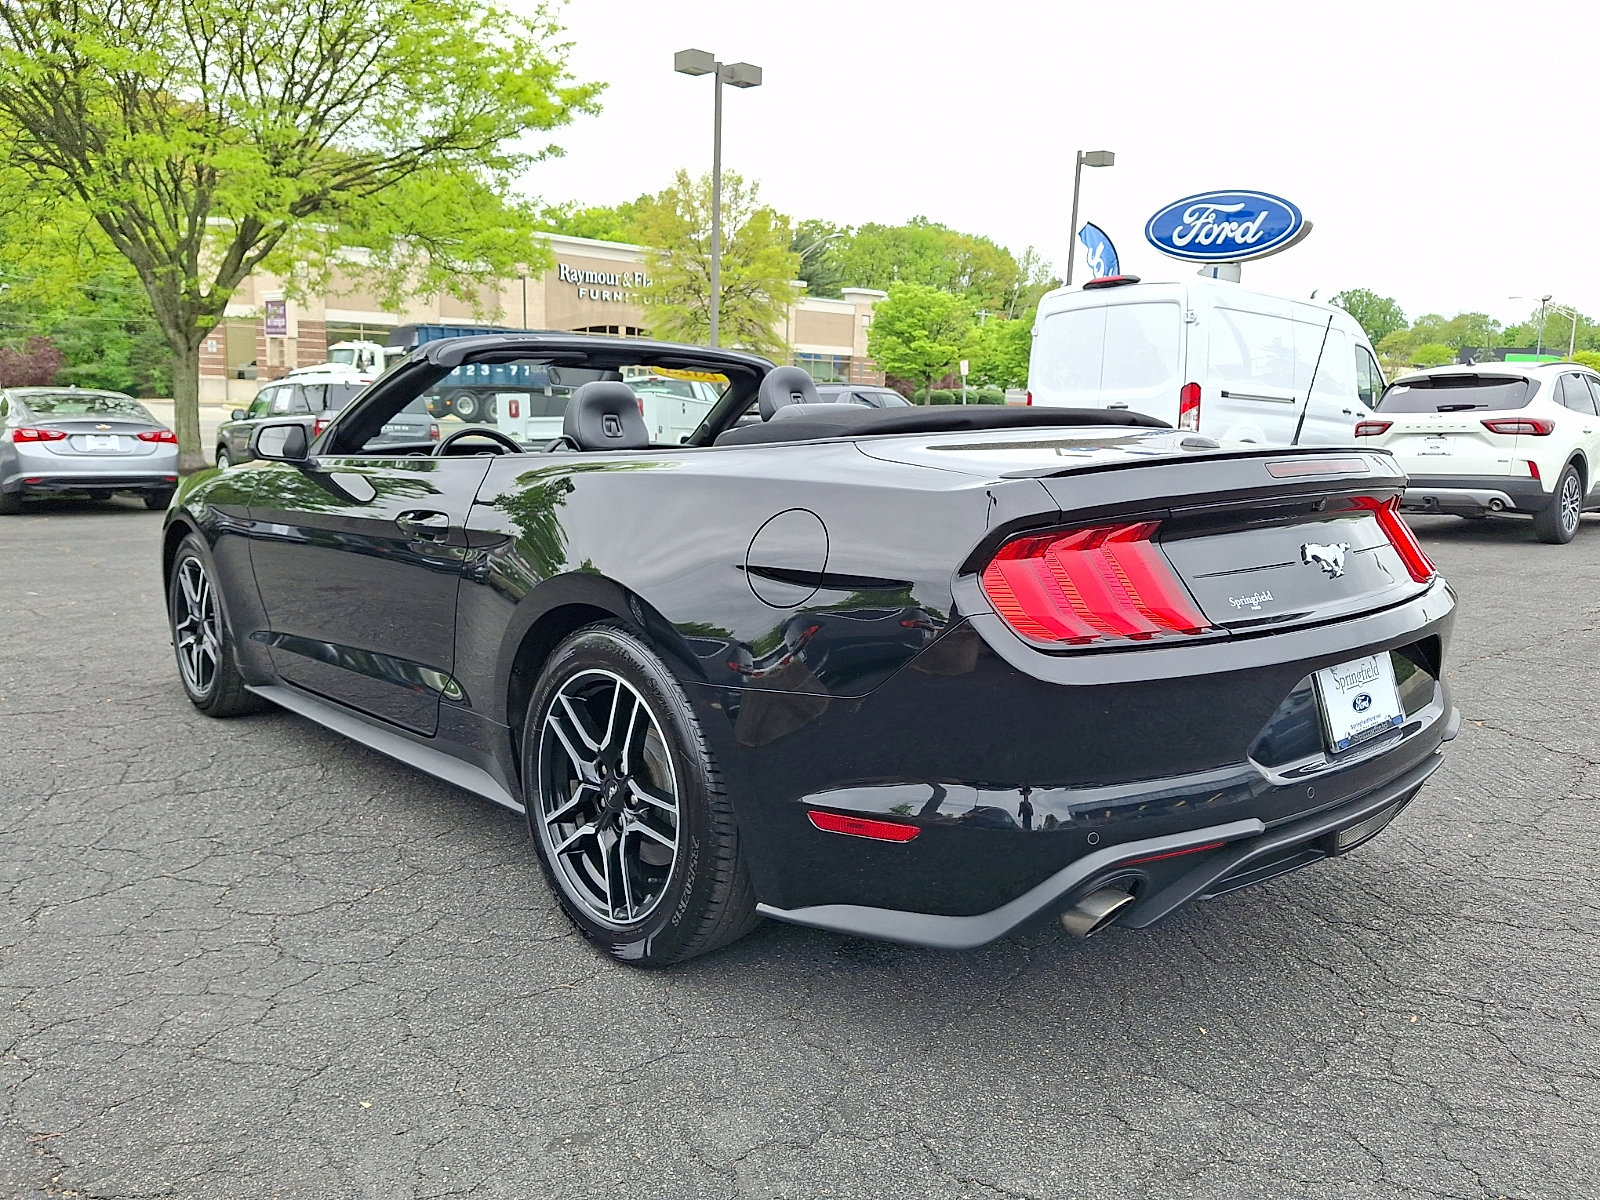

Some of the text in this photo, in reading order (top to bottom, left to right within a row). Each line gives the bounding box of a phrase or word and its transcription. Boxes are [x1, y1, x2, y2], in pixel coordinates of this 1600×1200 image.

[1172, 202, 1269, 247] Ford
[559, 263, 621, 286] Raymour
[622, 271, 633, 289] &
[1228, 590, 1274, 609] Springfield
[1330, 655, 1380, 694] Springfield
[671, 835, 700, 927] 235/50ZR18
